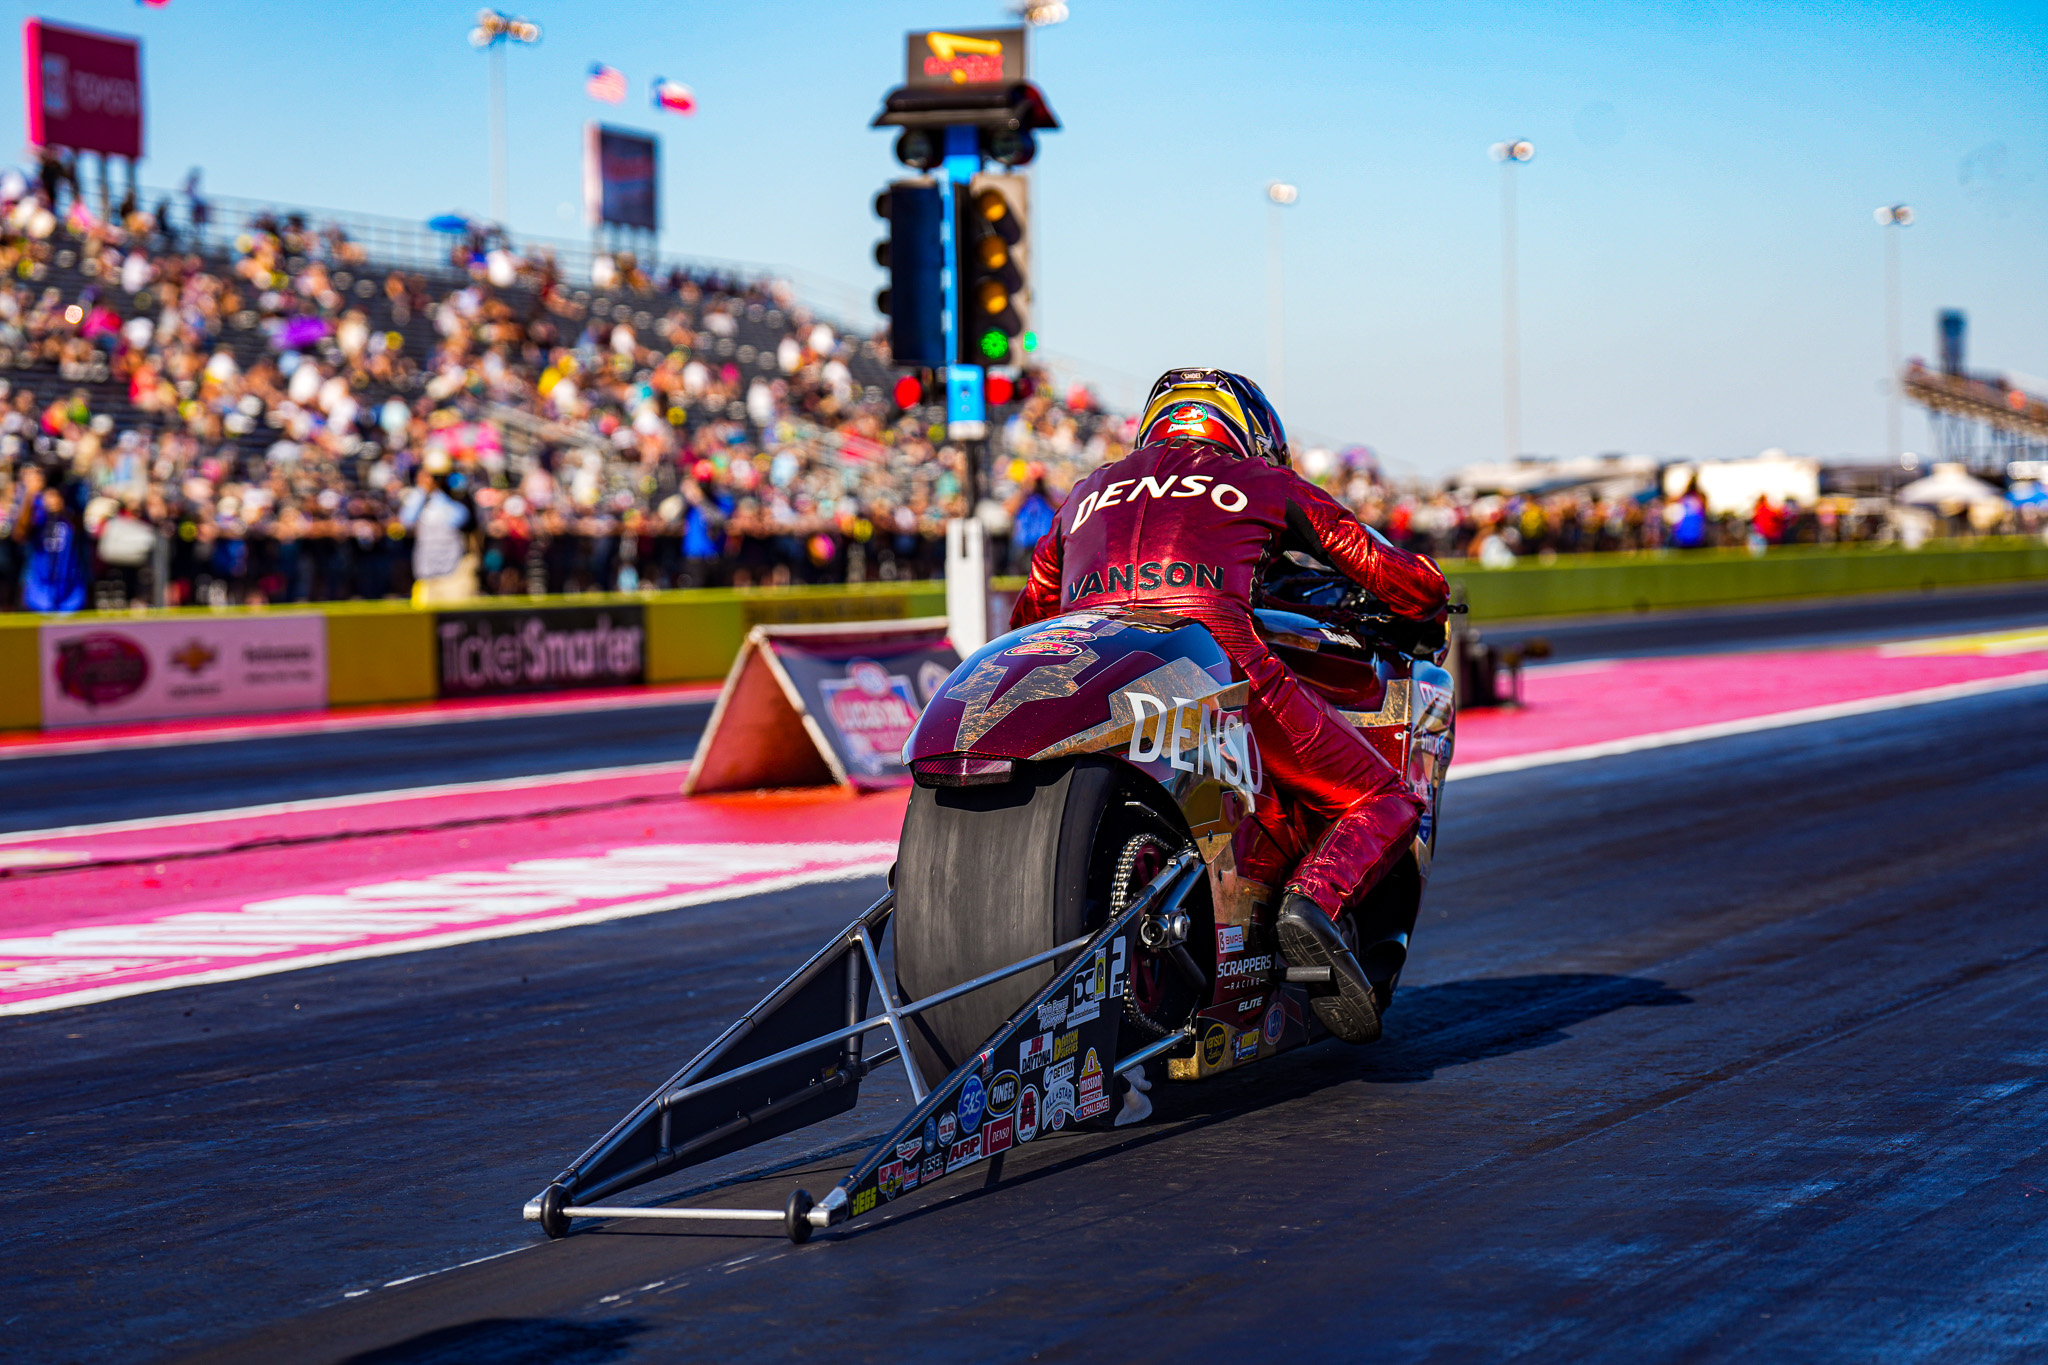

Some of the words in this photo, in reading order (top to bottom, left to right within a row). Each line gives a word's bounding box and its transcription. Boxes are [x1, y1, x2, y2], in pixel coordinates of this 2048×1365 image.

[1070, 475, 1248, 534] DENSO
[1068, 561, 1225, 603] VANSON
[1319, 628, 1362, 649] Buell
[1125, 692, 1263, 794] DENSO
[1110, 936, 1126, 998] 2
[1217, 955, 1272, 978] SCRAPPERS
[1230, 978, 1260, 990] RACING
[1238, 996, 1263, 1012] ELITE
[1022, 1048, 1051, 1073] DAYTONA
[992, 1081, 1015, 1105] PINGEL
[1083, 1099, 1108, 1116] CHALLENGE
[992, 1127, 1010, 1143] DENSO
[949, 1136, 980, 1162] ARP
[852, 1186, 877, 1216] JEGS
